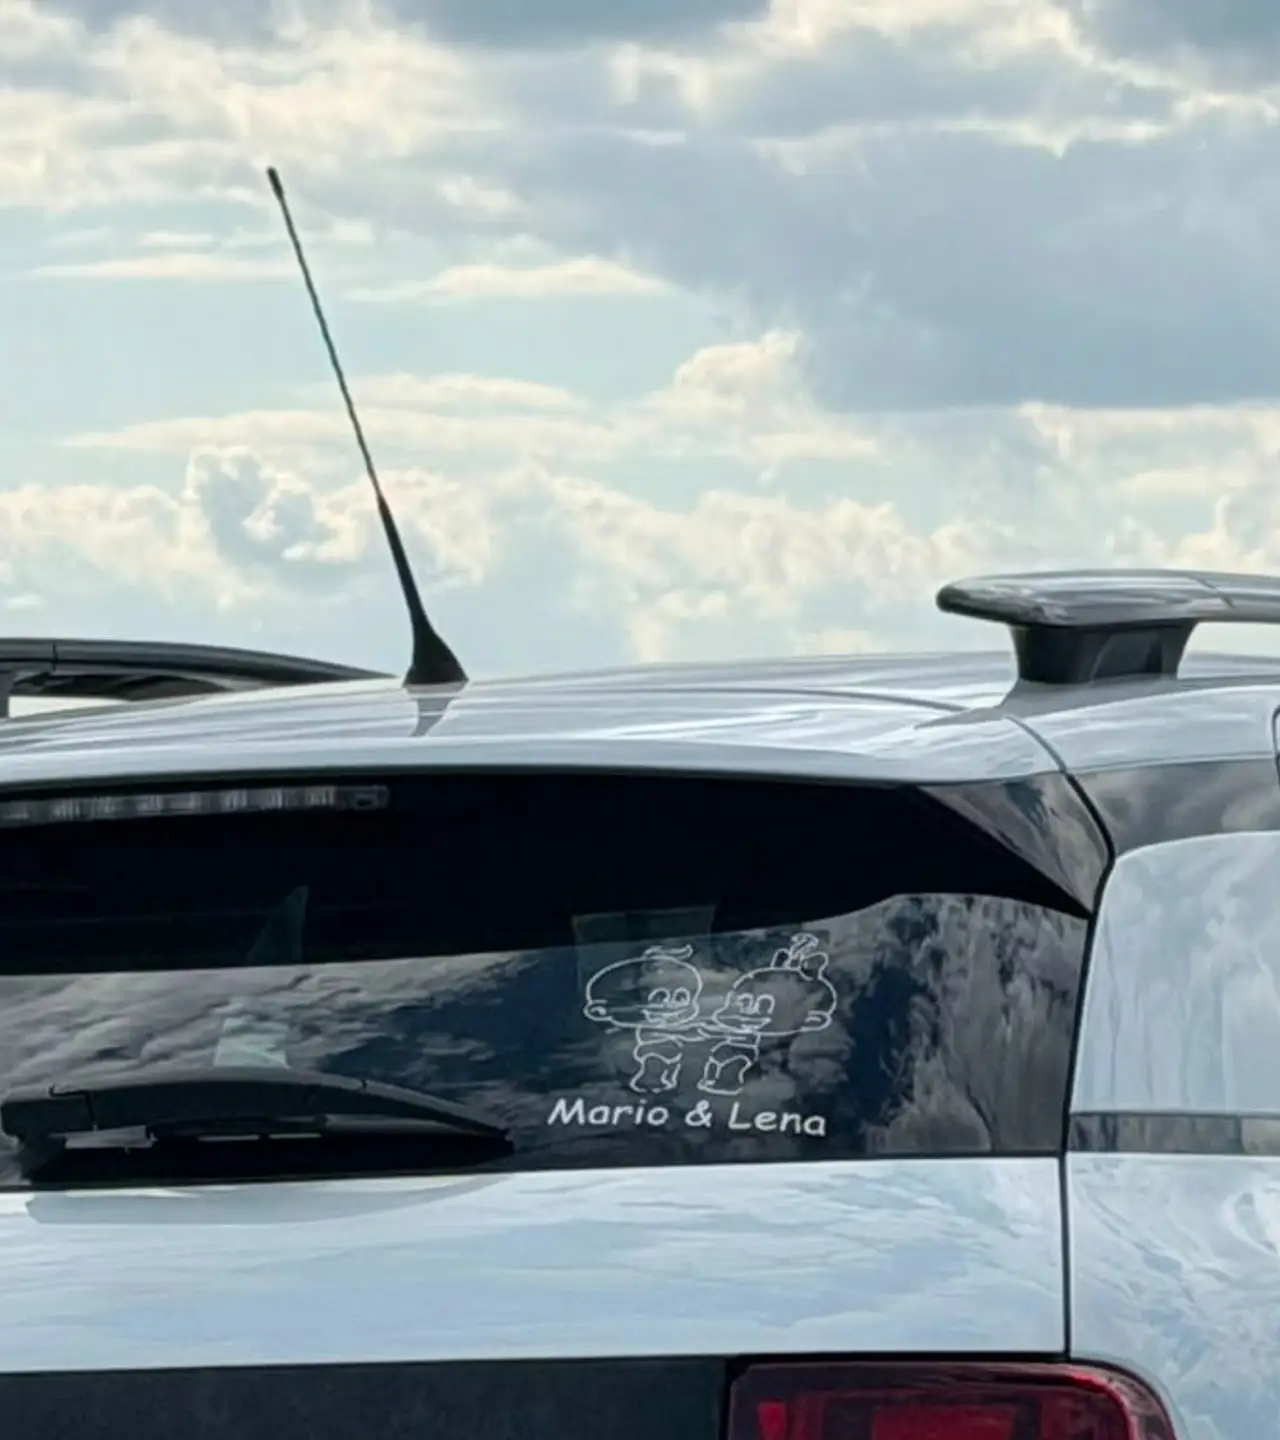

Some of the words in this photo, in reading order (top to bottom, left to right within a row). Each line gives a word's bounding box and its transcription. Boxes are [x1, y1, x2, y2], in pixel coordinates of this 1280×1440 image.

[548, 1098, 669, 1126] Mario
[685, 1098, 711, 1128] &
[728, 1102, 826, 1136] Lena
